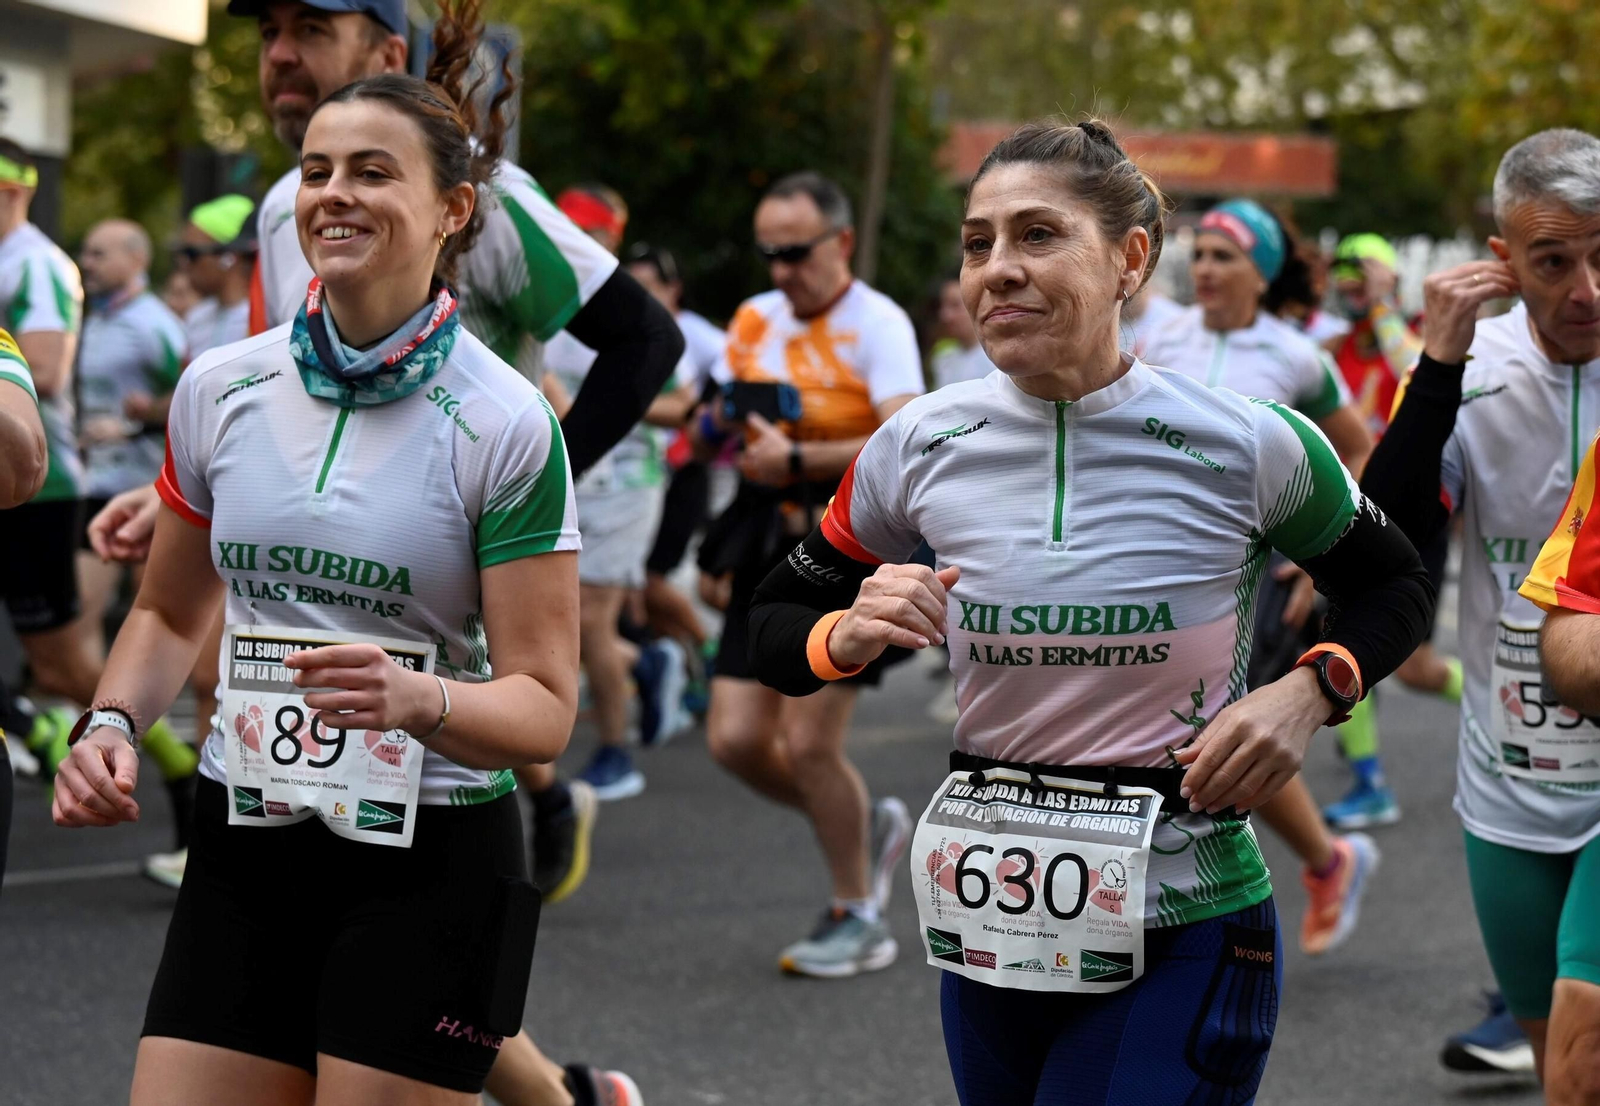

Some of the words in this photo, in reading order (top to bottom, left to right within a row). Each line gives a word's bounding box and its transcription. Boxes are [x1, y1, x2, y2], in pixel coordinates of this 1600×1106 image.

[453, 411, 480, 443] Laboral
[921, 417, 992, 457] FIREHAWK
[1141, 417, 1186, 450] SIG
[1183, 445, 1227, 475] Laboral
[218, 541, 260, 571] XII
[268, 545, 415, 596] SUBIDA
[232, 578, 243, 597] A
[246, 579, 290, 602] LAS
[294, 584, 405, 618] ERMITAS
[959, 600, 1003, 635] XII
[1010, 602, 1178, 636] SUBIDA
[236, 641, 254, 657] XII
[969, 643, 982, 664] A
[984, 644, 1033, 667] LAS
[1040, 643, 1170, 667] ERMITAS
[234, 664, 256, 679] POR
[256, 665, 269, 681] LA
[271, 705, 347, 769] 89
[381, 746, 405, 755] TALLA
[270, 777, 289, 785] MARINA
[291, 778, 321, 788] TOSCANO
[950, 783, 973, 798] XII
[1020, 788, 1032, 805] A
[1035, 790, 1067, 809] LAS
[1069, 794, 1140, 813] ERMITAS
[938, 800, 966, 817] POR
[966, 806, 984, 822] LA
[1049, 813, 1070, 827] DE
[1070, 815, 1140, 835] ORGANOS
[955, 844, 1089, 920] 630
[1099, 890, 1125, 902] TALLA
[1109, 905, 1115, 913] S
[1000, 916, 1017, 924] dona
[1018, 917, 1046, 927] órganos
[1087, 917, 1110, 927] Regala
[983, 924, 1006, 934] Rafaela
[1007, 928, 1036, 938] Cabrera
[1037, 931, 1059, 939] Pérez
[1086, 926, 1104, 935] dona
[1105, 928, 1133, 938] órganos
[971, 952, 996, 964] IMDECO
[1234, 945, 1273, 963] WONG
